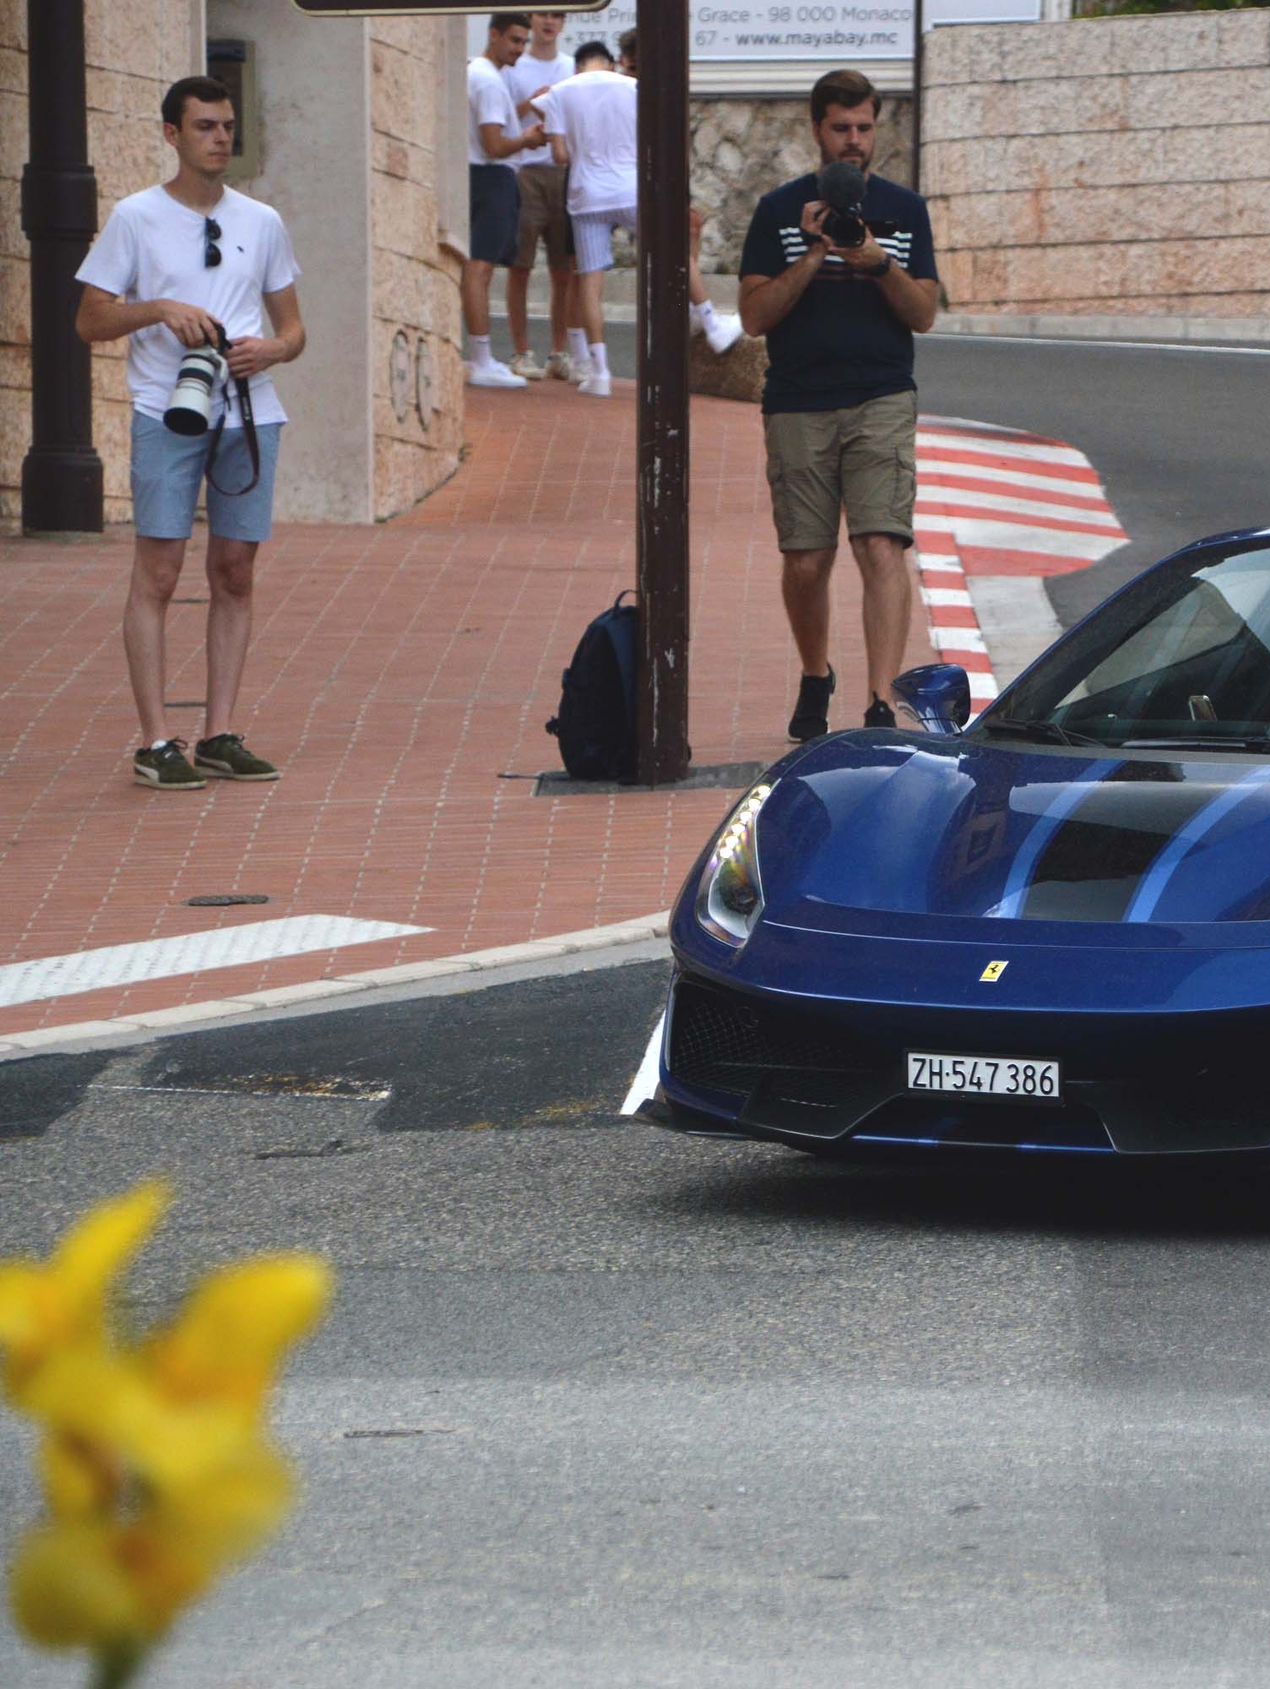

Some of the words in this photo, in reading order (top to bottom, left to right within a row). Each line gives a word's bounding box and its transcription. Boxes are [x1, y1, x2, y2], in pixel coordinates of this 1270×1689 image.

[697, 7, 750, 22] Grace
[768, 7, 790, 22] 98
[797, 7, 837, 22] 000
[841, 7, 912, 22] Monaco
[735, 30, 898, 48] www.mayabay.mc
[1006, 1063, 1054, 1096] 386
